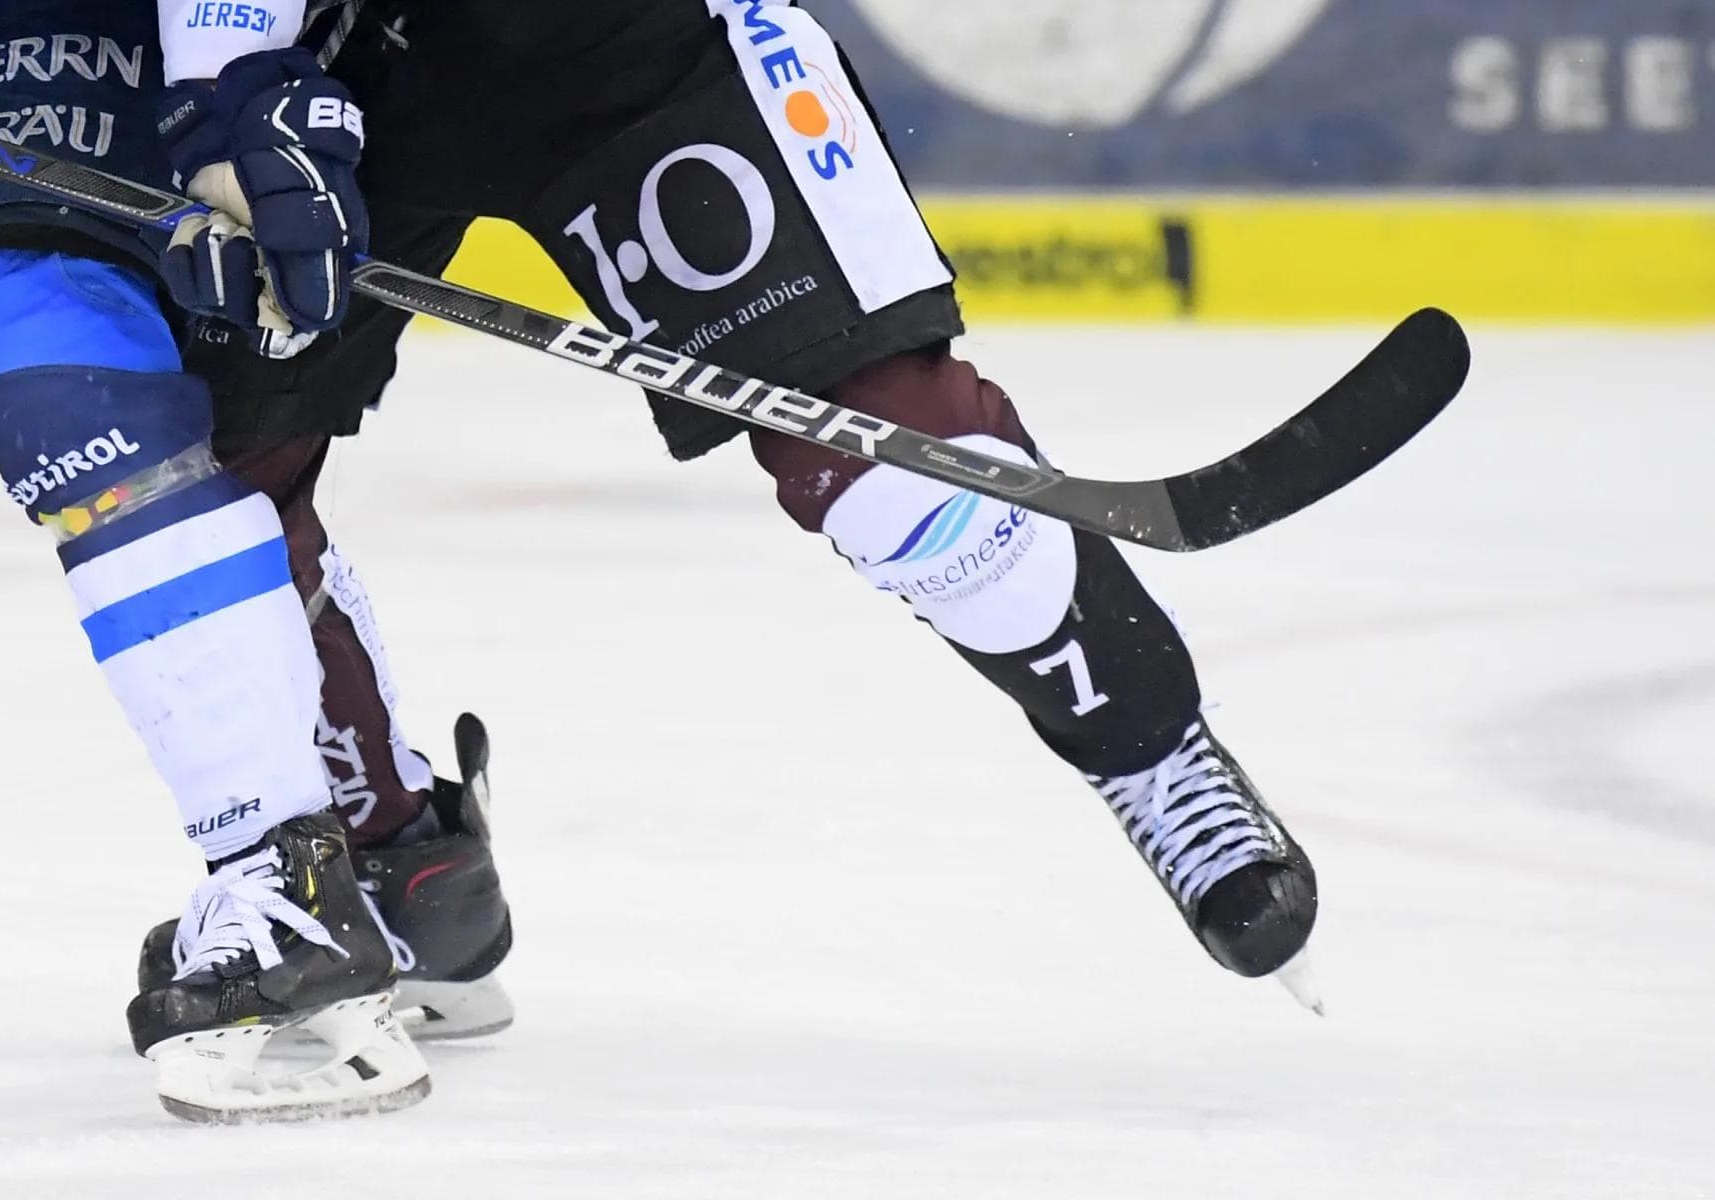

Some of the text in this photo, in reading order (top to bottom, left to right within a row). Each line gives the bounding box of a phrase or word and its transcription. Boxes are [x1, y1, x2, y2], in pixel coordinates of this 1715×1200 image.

[1448, 34, 1715, 133] SEE
[677, 273, 819, 360] coffea arabica
[1029, 638, 1110, 716] 7
